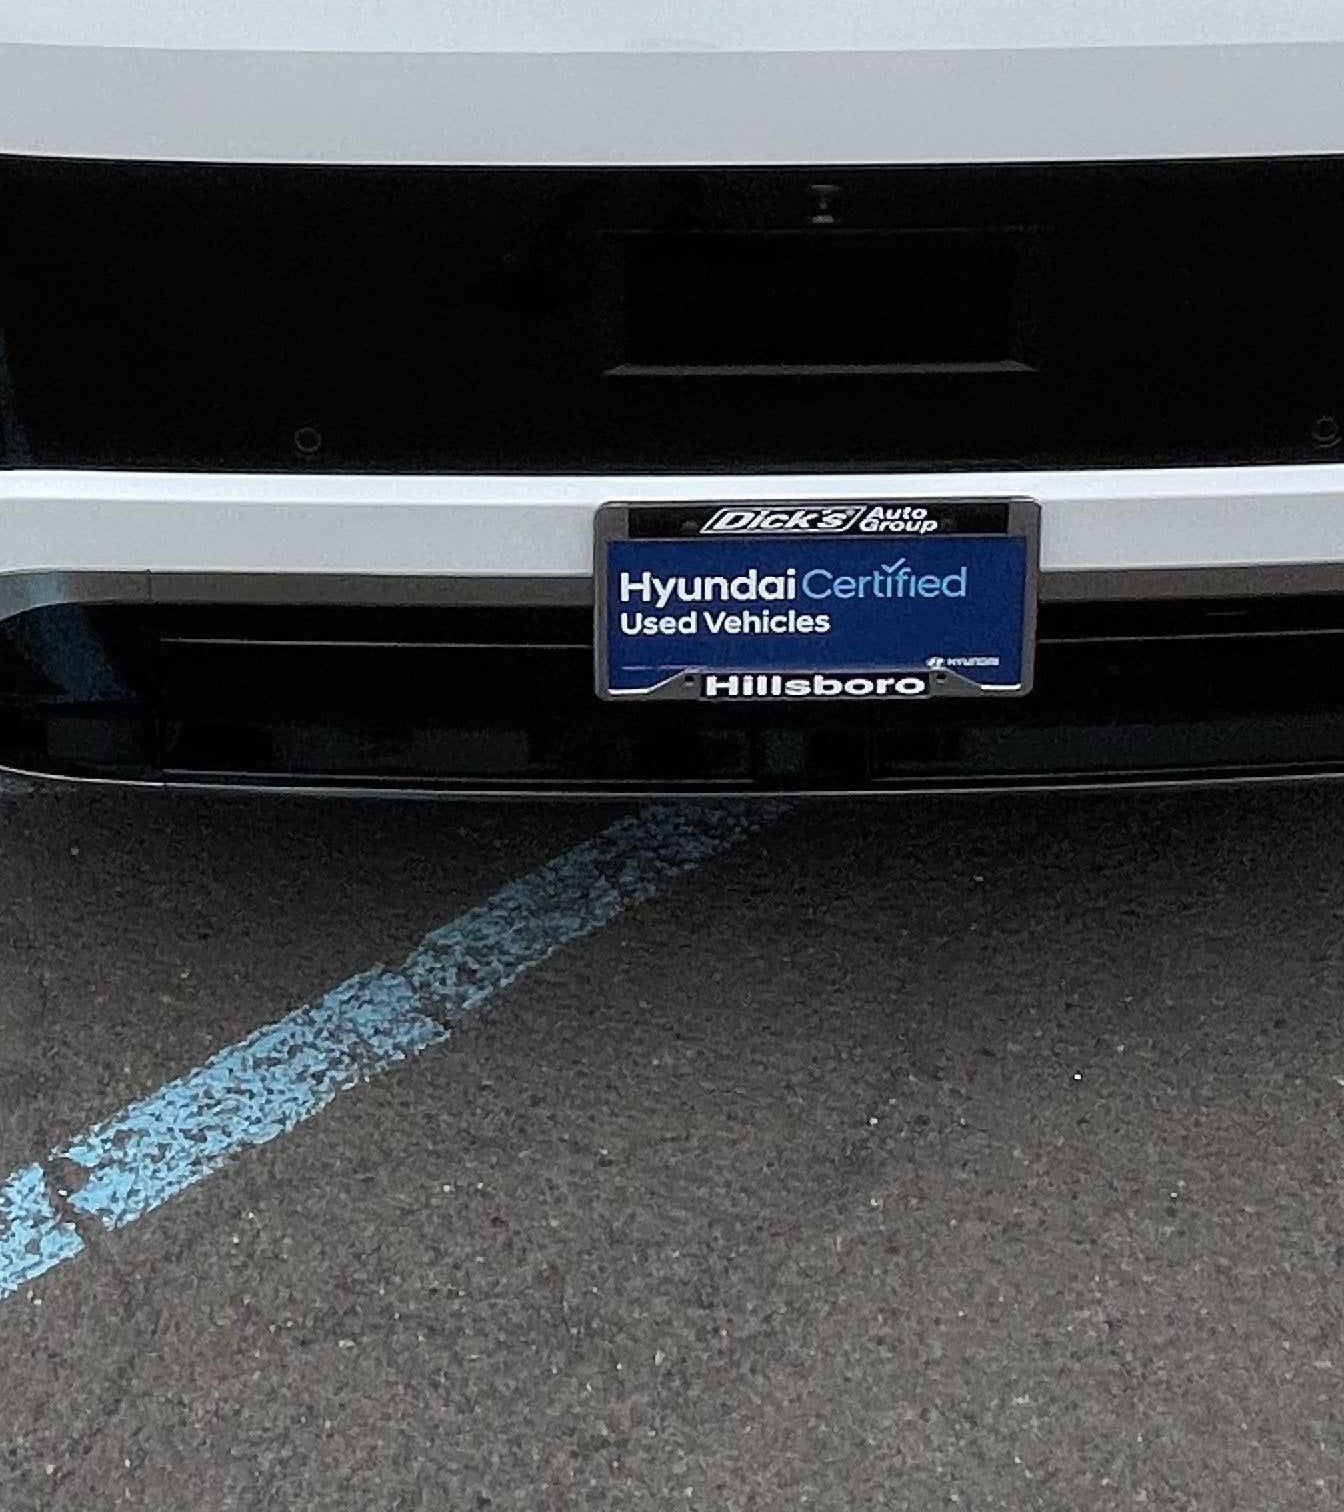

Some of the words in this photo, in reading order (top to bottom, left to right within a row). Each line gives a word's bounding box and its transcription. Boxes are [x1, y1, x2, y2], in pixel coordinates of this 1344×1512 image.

[867, 506, 928, 520] Auto
[859, 519, 938, 534] Group
[621, 568, 796, 607] Hyundai
[803, 561, 967, 598] Certified
[621, 611, 697, 635] Used
[703, 610, 831, 633] Vehicles
[706, 675, 926, 696] Hillsboro
